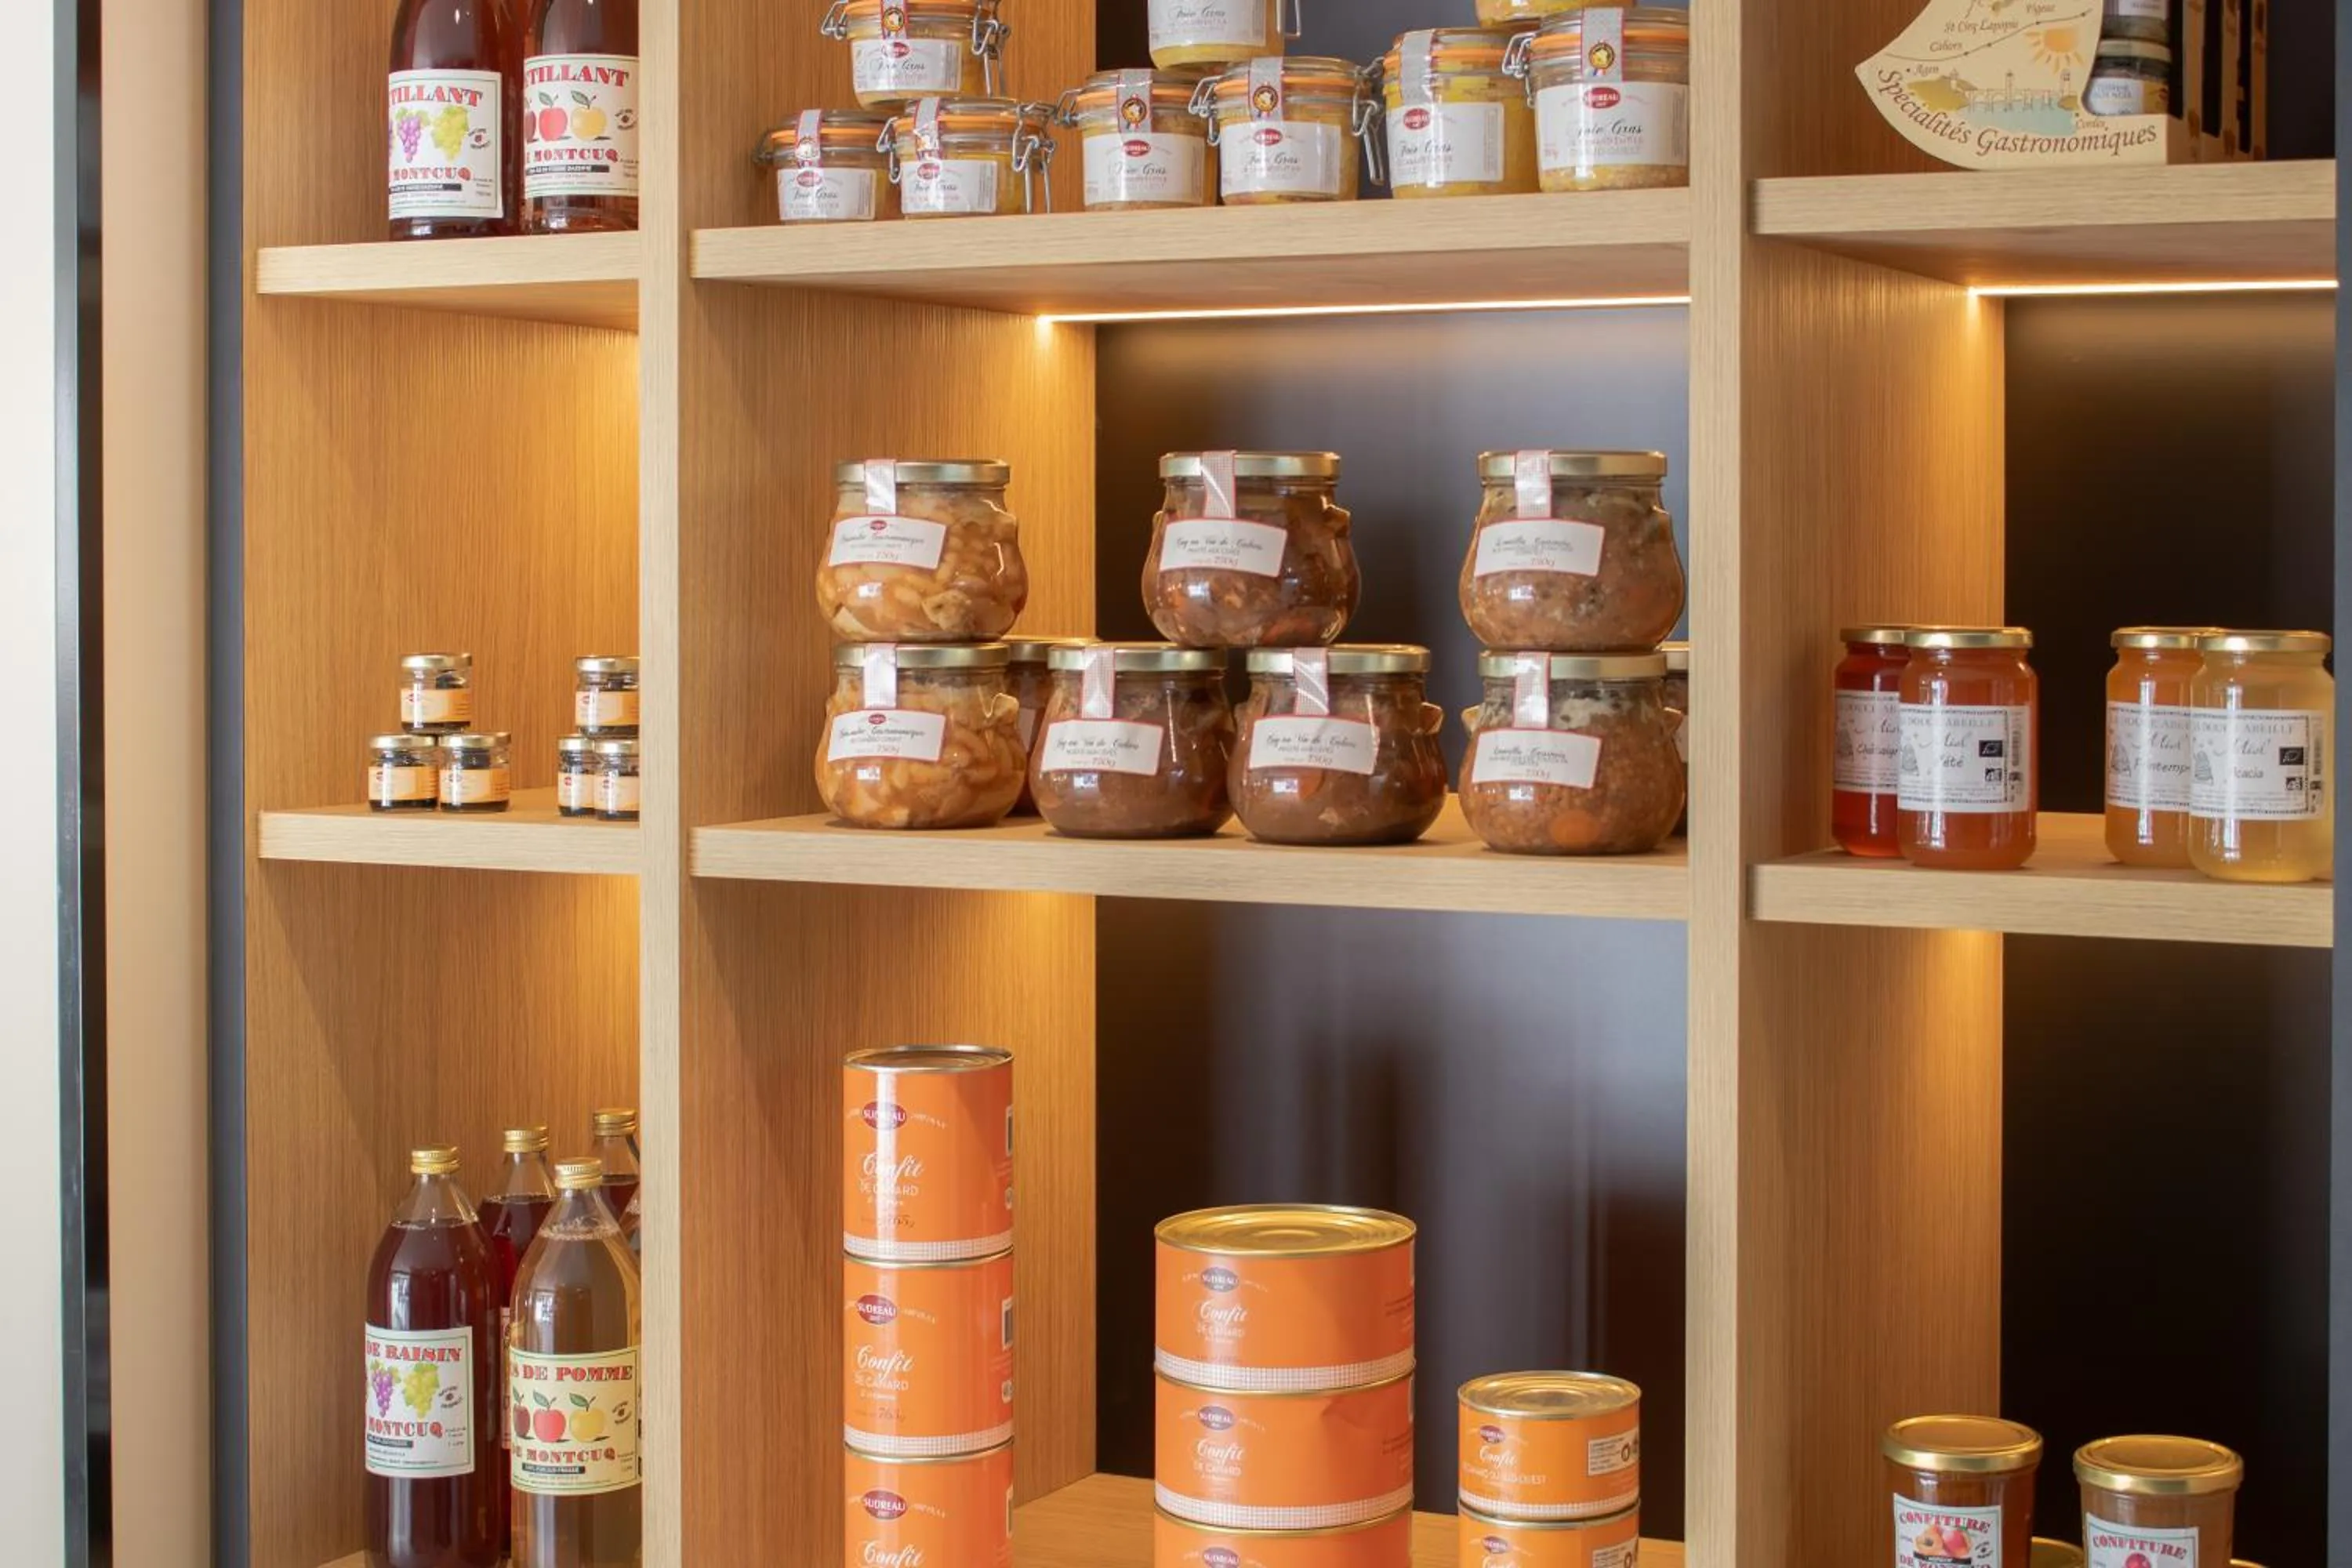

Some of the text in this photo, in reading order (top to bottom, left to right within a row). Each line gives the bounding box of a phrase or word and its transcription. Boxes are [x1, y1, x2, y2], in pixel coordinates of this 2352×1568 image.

[1914, 64, 1940, 76] Agen
[1878, 68, 2158, 157] Spécialités Gastronomiques
[1200, 1301, 1248, 1326] Confit
[366, 1341, 462, 1363] DE RAISIN
[855, 1343, 916, 1381] Confit
[523, 1364, 548, 1381] DE
[555, 1365, 633, 1382] POMME
[368, 1417, 444, 1439] MONTCUQ
[527, 1446, 616, 1465] MONTCUQ
[1196, 1439, 1245, 1466] Confit
[1899, 1511, 1991, 1534] CONFITURE
[863, 1539, 924, 1568] Confit
[2092, 1534, 2188, 1561] CONFITURE
